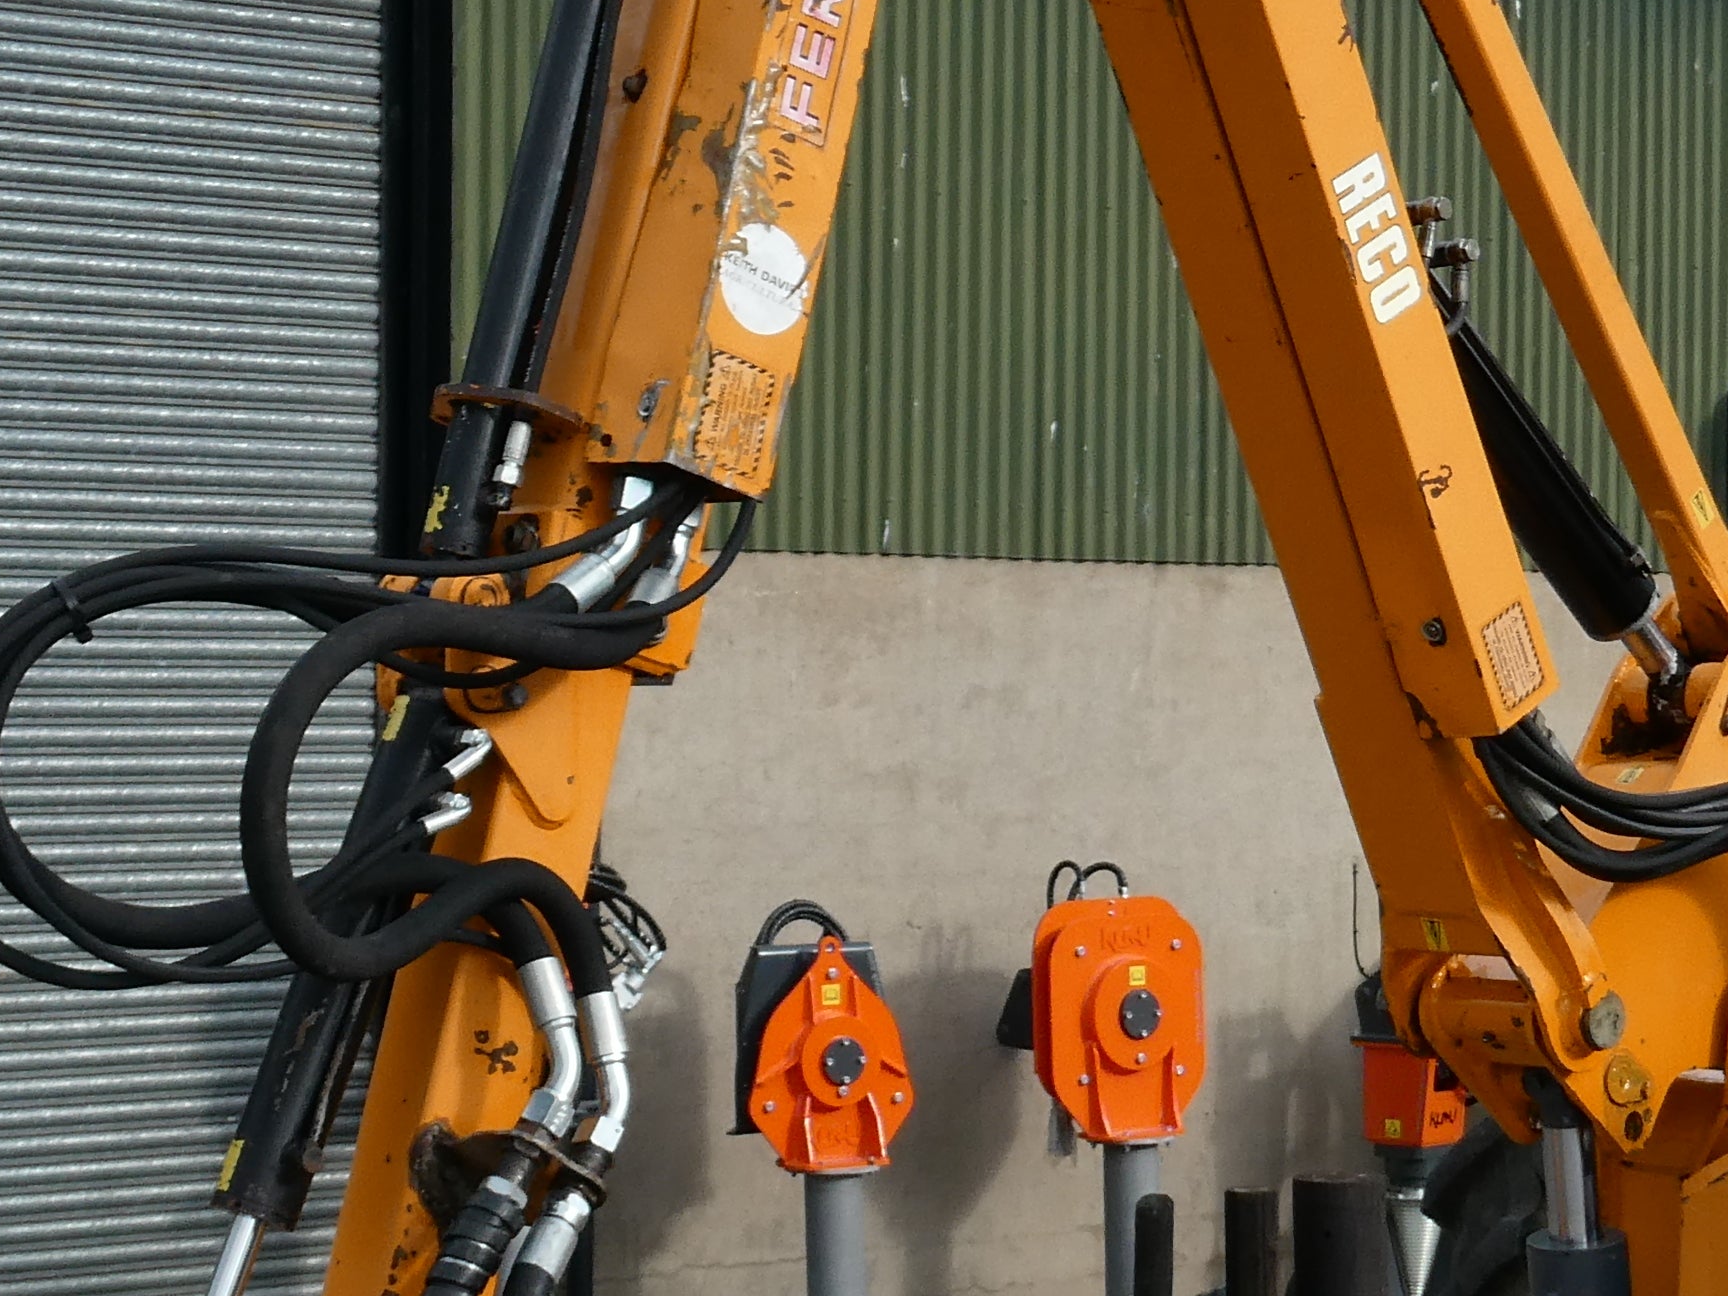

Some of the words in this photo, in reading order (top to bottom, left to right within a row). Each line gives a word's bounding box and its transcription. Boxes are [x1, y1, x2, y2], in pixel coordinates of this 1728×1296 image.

[1331, 151, 1422, 325] RECO
[724, 253, 759, 276] KEITH
[712, 383, 728, 432] WARNING
